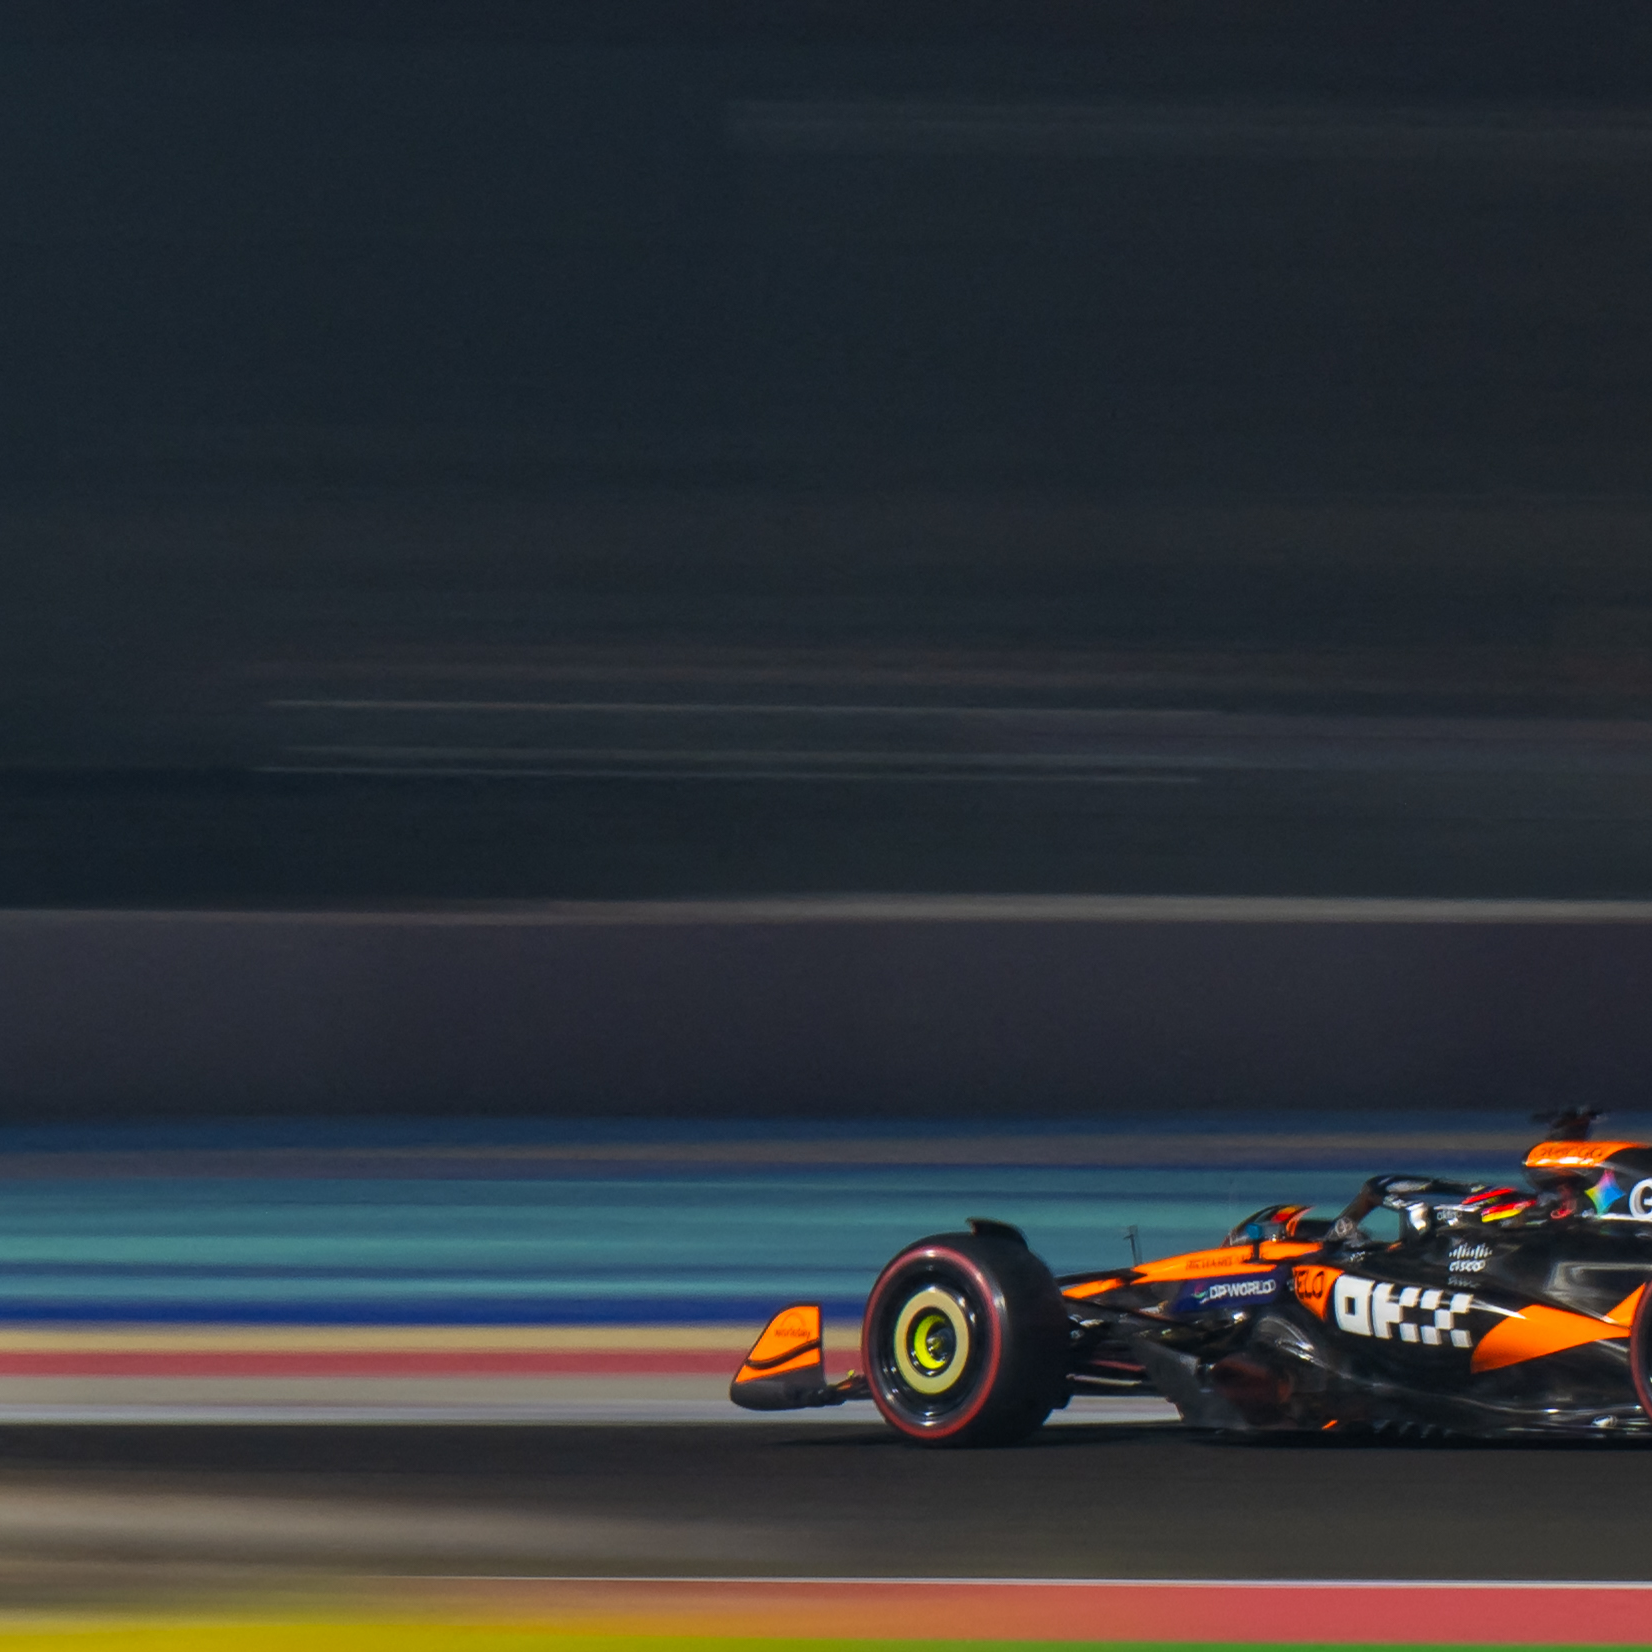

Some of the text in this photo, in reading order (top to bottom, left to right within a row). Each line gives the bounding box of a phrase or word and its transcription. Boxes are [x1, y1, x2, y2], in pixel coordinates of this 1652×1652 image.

[1449, 1259, 1486, 1273] cisco
[1293, 1269, 1325, 1300] ELO
[1335, 1274, 1474, 1348] OKX
